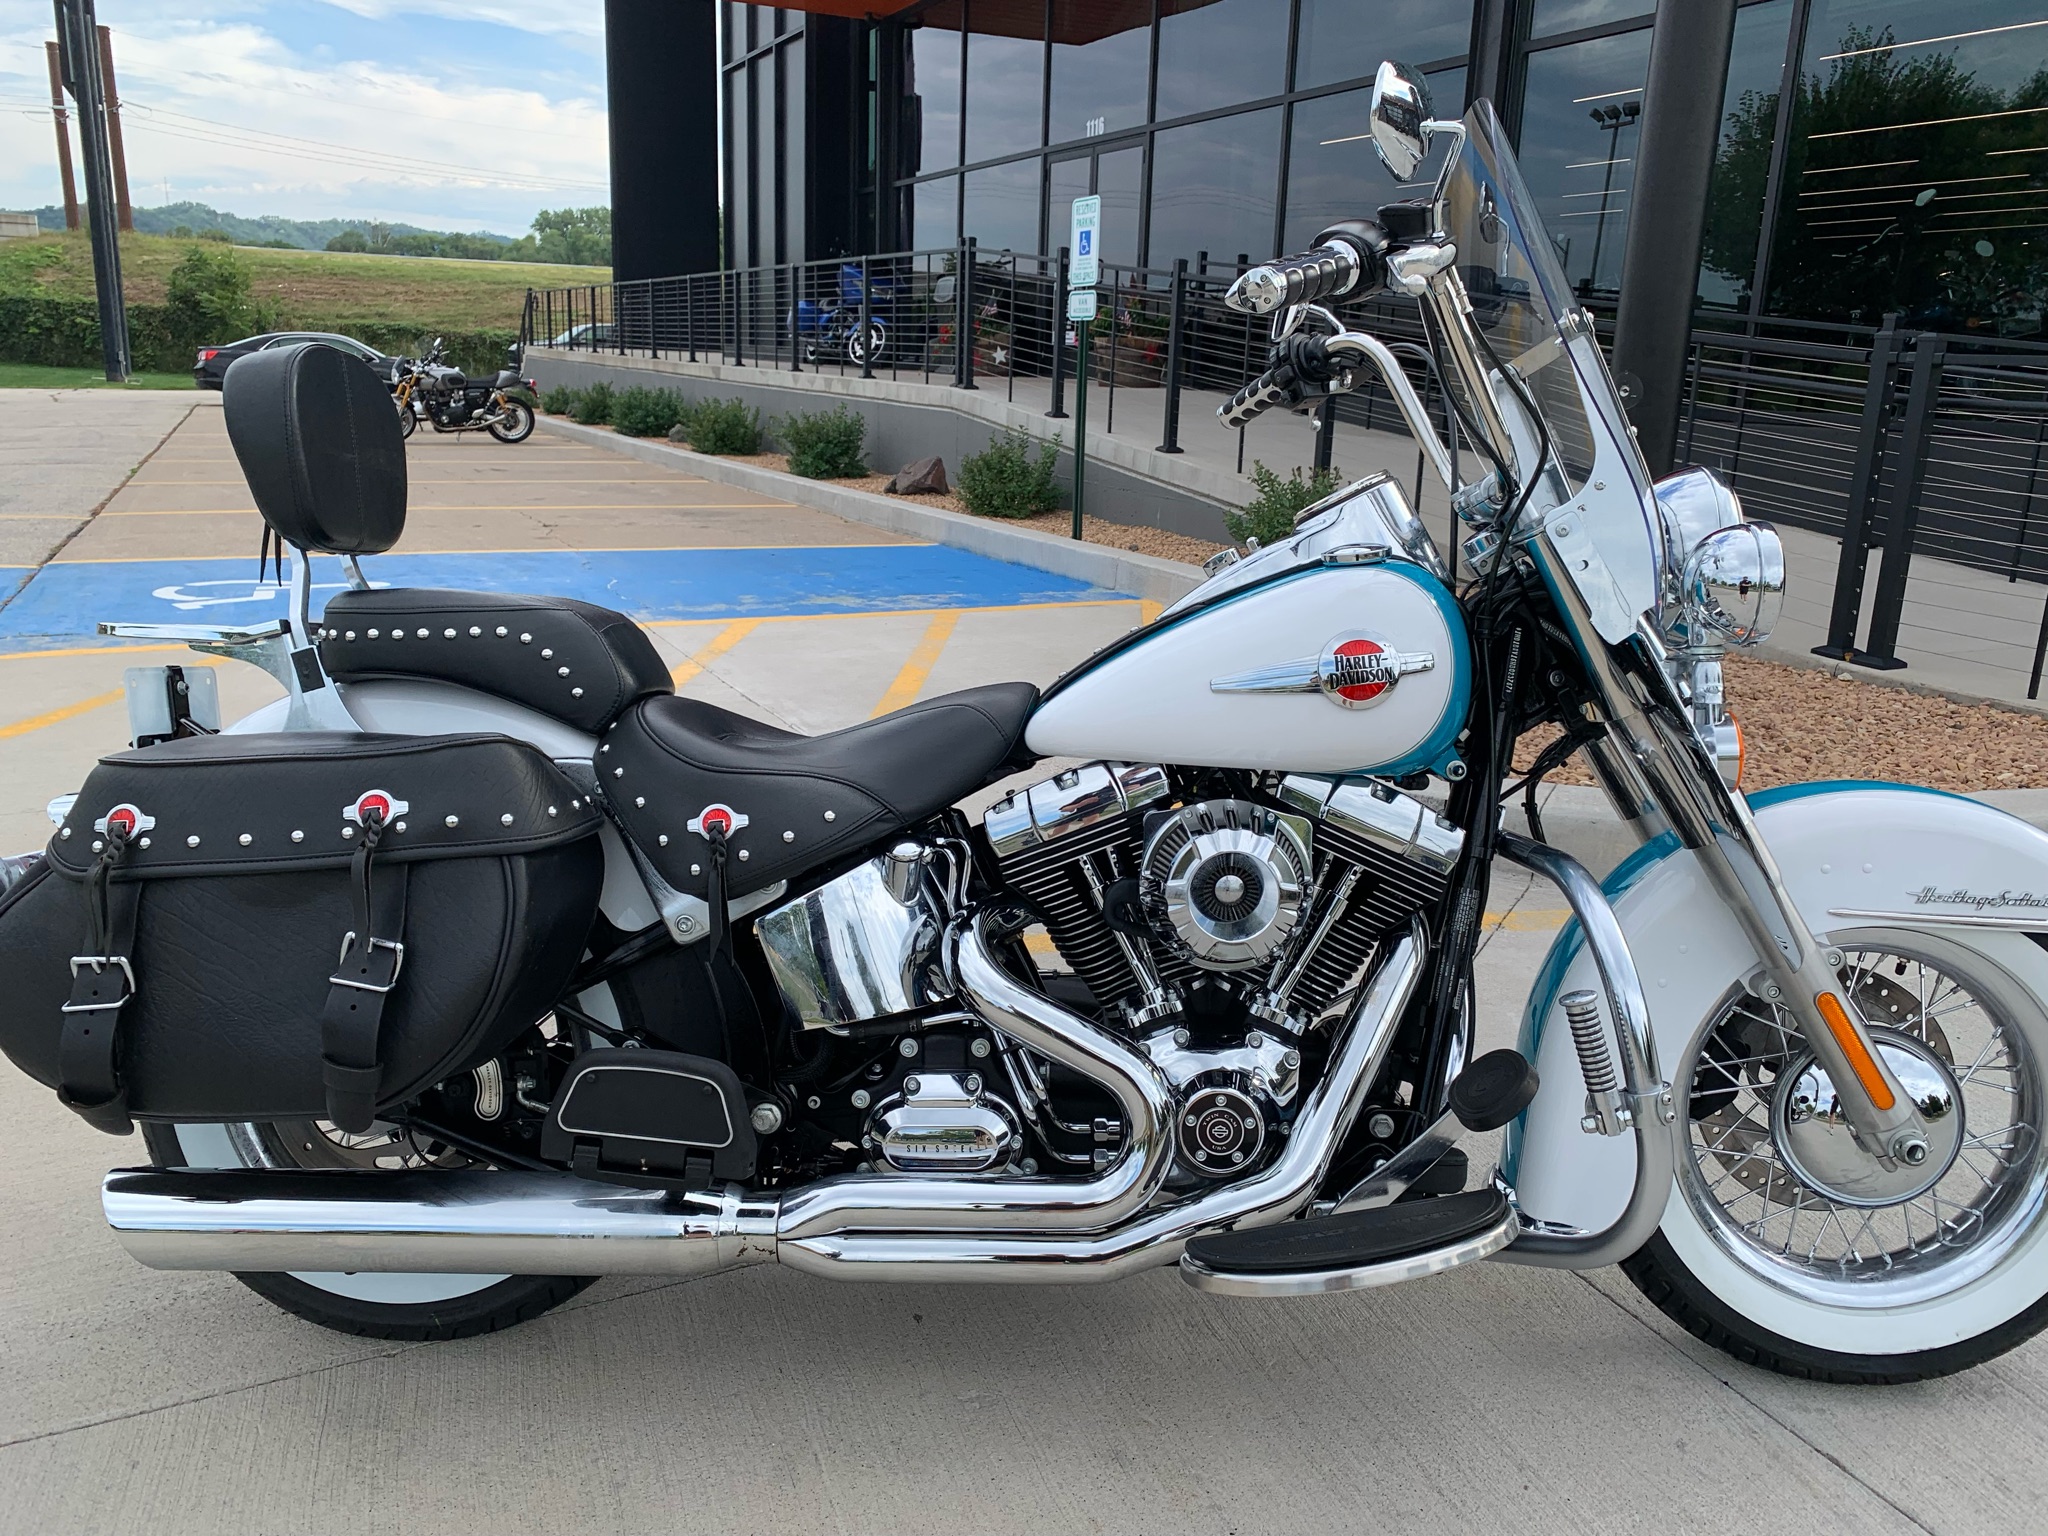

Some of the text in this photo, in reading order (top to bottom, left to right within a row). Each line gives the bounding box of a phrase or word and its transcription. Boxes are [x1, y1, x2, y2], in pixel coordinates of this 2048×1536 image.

[1086, 116, 1104, 137] 1116
[1076, 202, 1096, 215] RESERVED
[1076, 216, 1096, 228] PARKING
[1083, 271, 1094, 280] SPACE
[1334, 653, 1388, 672] HARLEY-
[1329, 667, 1394, 690] DAVIDSON
[1905, 886, 1998, 911] Heritage
[1203, 1113, 1238, 1127] TWIN CAM
[906, 1144, 926, 1153] SIX
